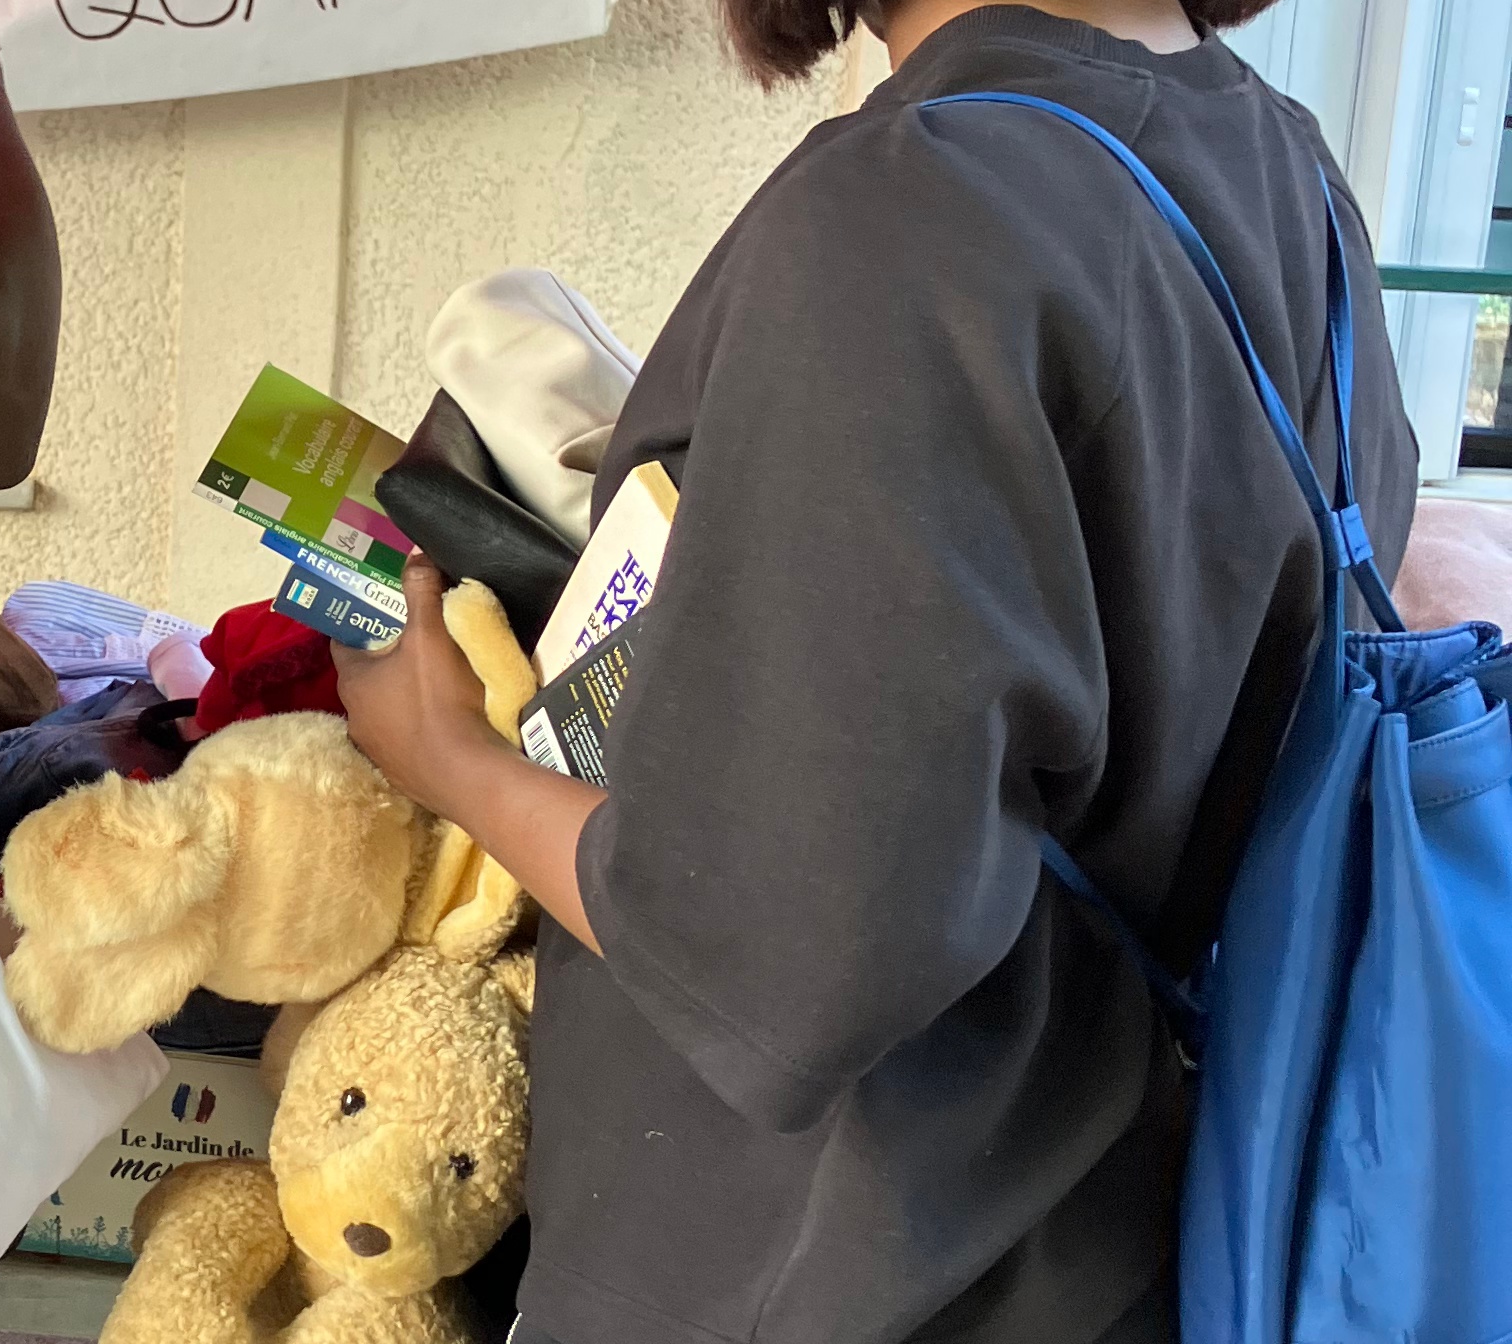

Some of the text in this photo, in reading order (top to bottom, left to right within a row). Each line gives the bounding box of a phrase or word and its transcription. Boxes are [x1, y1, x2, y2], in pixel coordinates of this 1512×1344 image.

[293, 418, 337, 476] Vocabulaire
[318, 416, 365, 489] anglais courant
[216, 471, 235, 490] 2€
[236, 506, 275, 531] courant
[272, 523, 309, 547] anglais
[305, 539, 361, 571] Vocabulaire
[296, 547, 364, 590] FRENCH
[363, 581, 409, 617] Gram
[368, 570, 388, 585] Piat
[620, 549, 653, 601] THE
[607, 569, 639, 619] RA
[348, 612, 403, 642] gique
[120, 1128, 255, 1159] Le Jardin de
